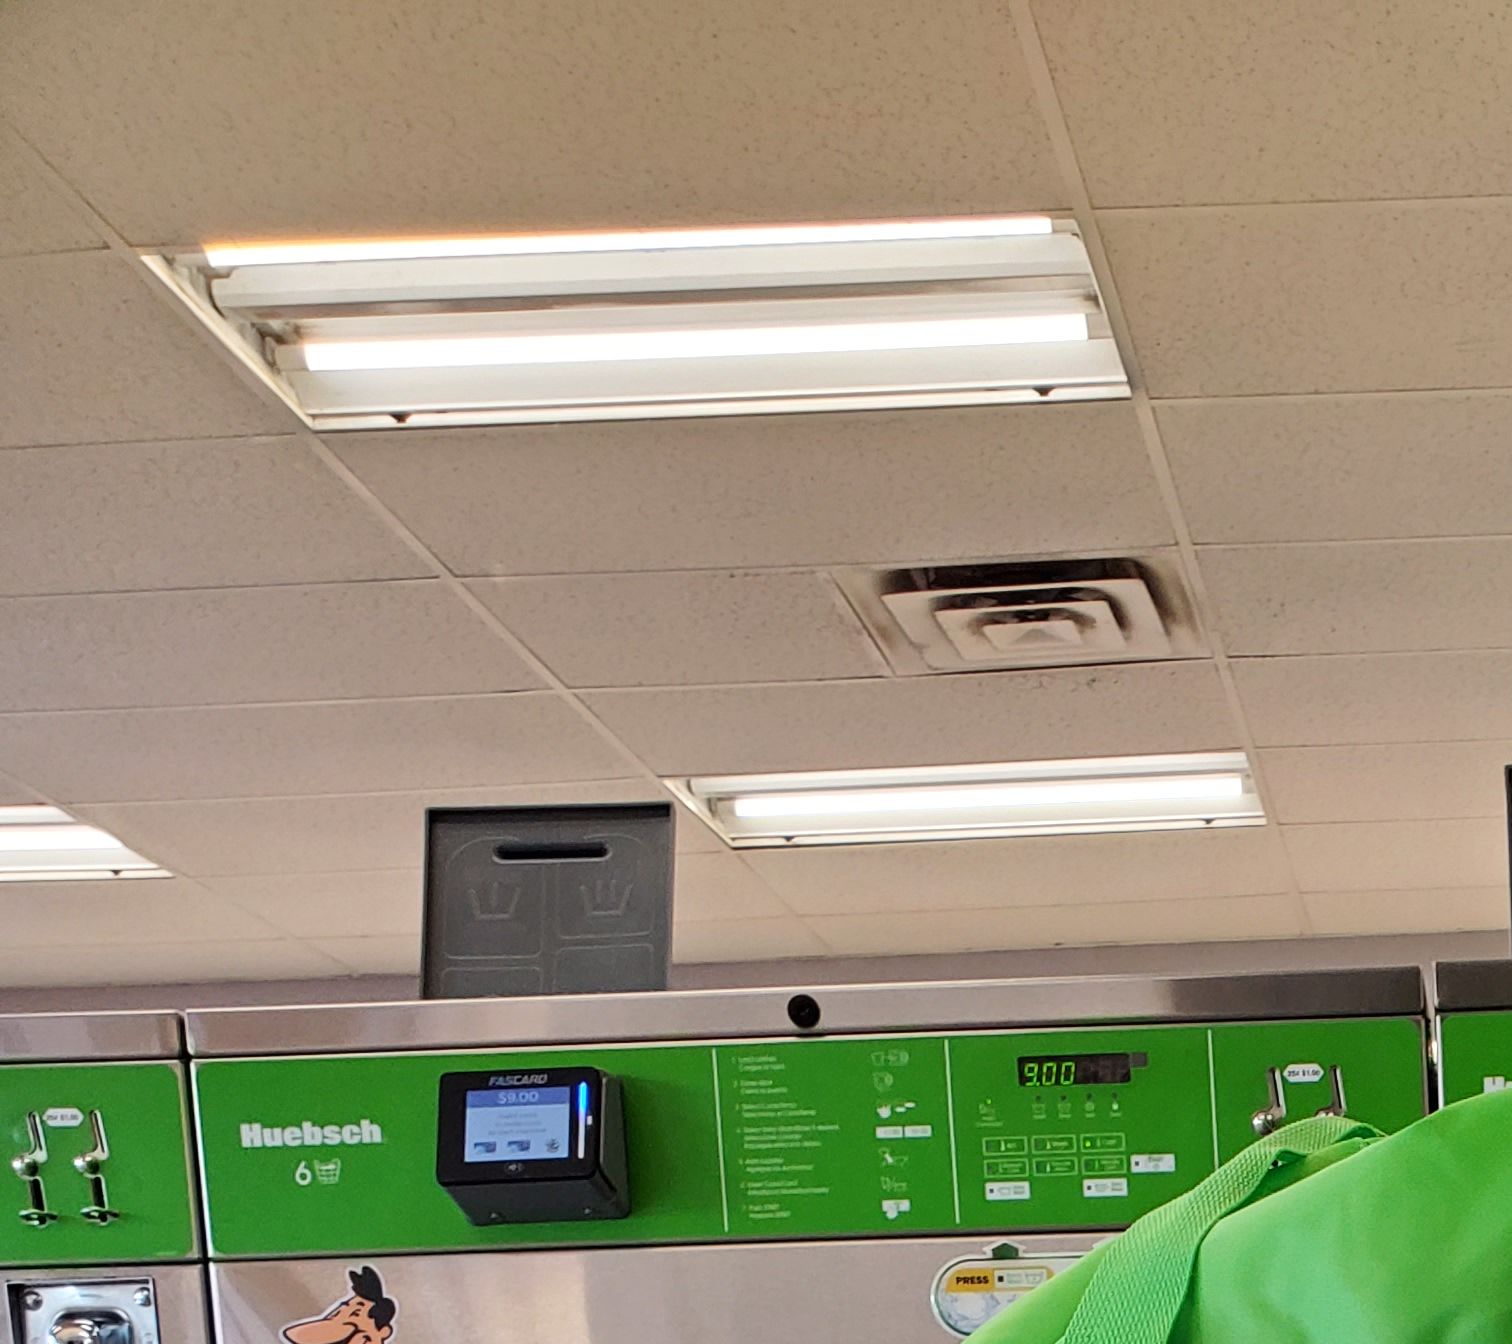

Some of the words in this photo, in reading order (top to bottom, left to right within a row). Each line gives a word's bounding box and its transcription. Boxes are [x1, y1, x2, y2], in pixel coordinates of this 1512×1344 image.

[487, 1073, 548, 1087] FASCARD
[1023, 1061, 1076, 1087] 9.00
[239, 1118, 383, 1149] Huebsch
[295, 1160, 312, 1186] 6
[955, 1275, 989, 1285] PRESS
